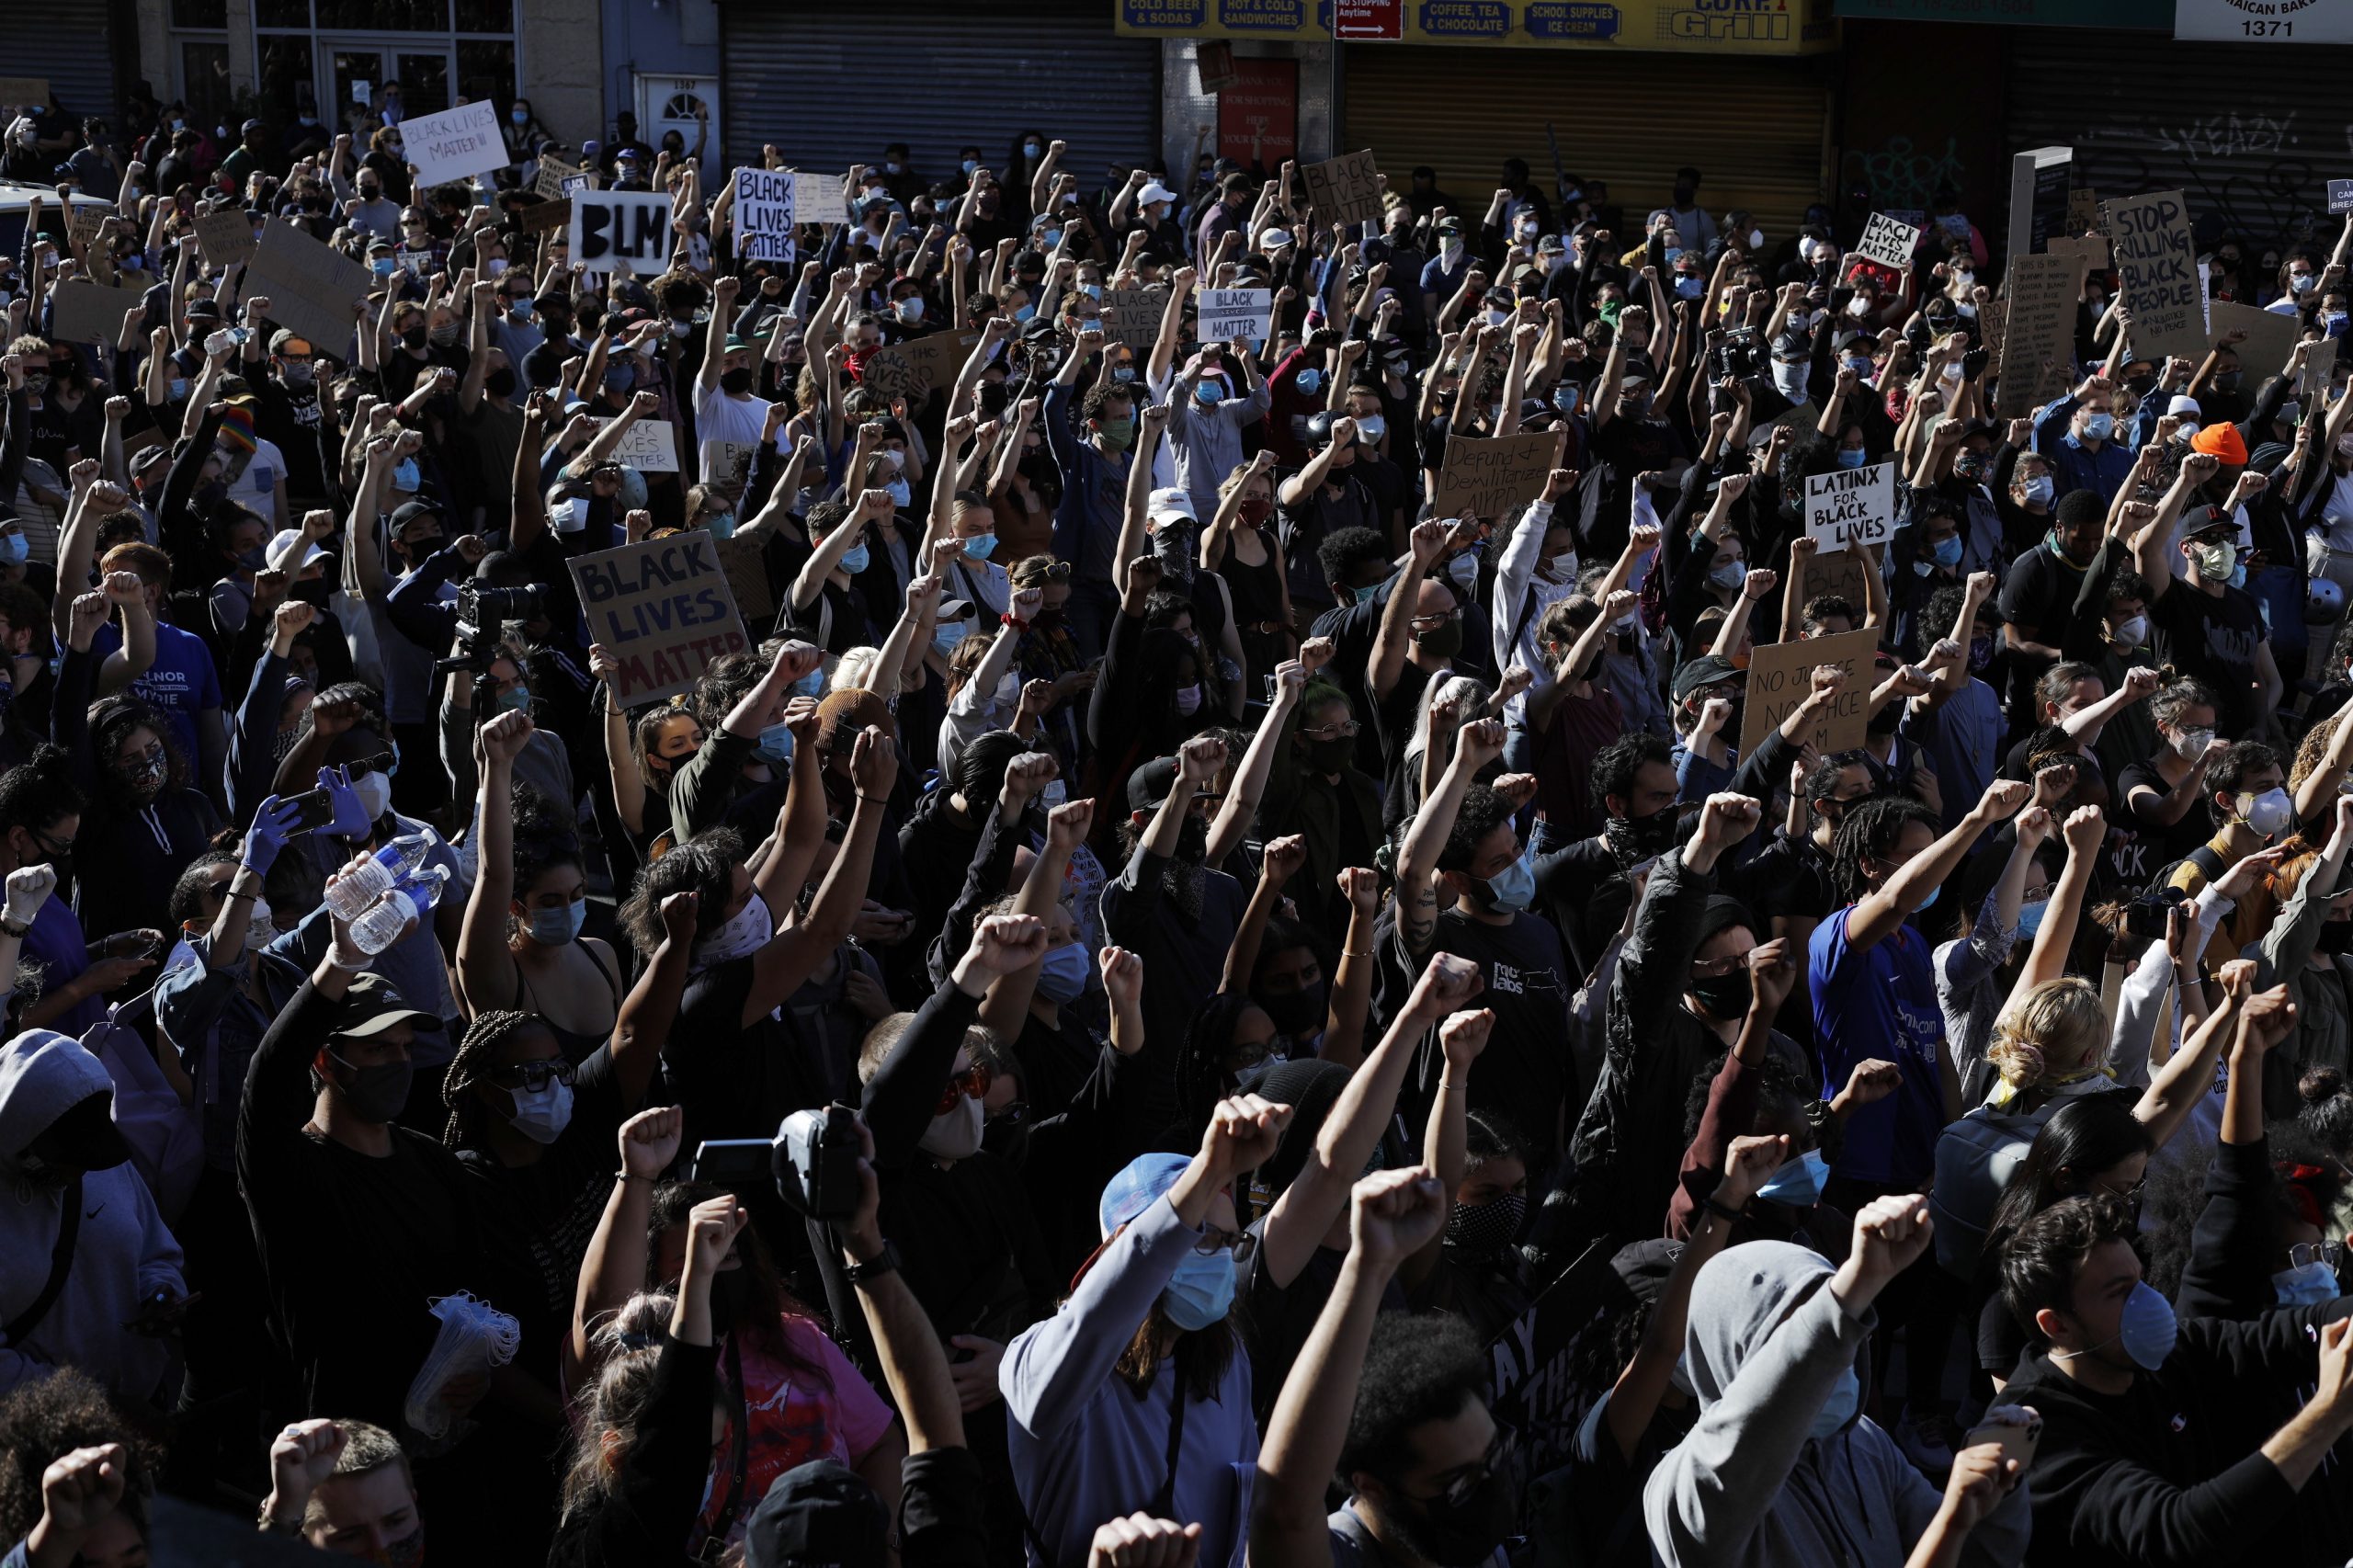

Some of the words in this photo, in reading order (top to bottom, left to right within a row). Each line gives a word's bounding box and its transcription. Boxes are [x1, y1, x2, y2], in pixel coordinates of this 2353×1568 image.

[1130, 0, 1165, 10] COLD
[1167, 0, 1199, 10] BEER
[1136, 13, 1146, 23] &
[1150, 13, 1192, 24] SODAS
[1227, 0, 1249, 10] HOT
[1265, 0, 1295, 11] COLD
[1339, 7, 1371, 18] Anytime
[1430, 5, 1474, 17] COFFEE,
[1479, 6, 1500, 17] TEA
[1532, 6, 1566, 17] SCHOOL
[1570, 6, 1614, 19] SUPPLIES
[1223, 13, 1299, 26] SANDWICHES
[1426, 18, 1434, 28] &
[1437, 18, 1504, 31] CHOCOLATE
[1548, 21, 1563, 32] ICE
[1564, 22, 1596, 33] CREAM
[1671, 10, 1790, 40] Grill
[2242, 20, 2293, 37] 1371
[1237, 75, 1264, 85] HANK
[404, 119, 452, 144] BLACK
[453, 108, 494, 132] LIVES
[1251, 136, 1293, 145] BSINESS
[1308, 157, 1373, 188] BLACK
[742, 172, 791, 204] BLACK
[1313, 176, 1376, 207] LIVES
[744, 203, 791, 233] LIVES
[1319, 195, 1385, 229] MATTER
[2117, 200, 2179, 236] STOP
[582, 203, 666, 259] BLM
[2118, 228, 2189, 261] KILLING
[1858, 241, 1906, 265] MATTER
[2123, 257, 2189, 290] BLACK
[1103, 293, 1162, 308] BLACK
[1216, 291, 1255, 307] BLACK
[2127, 283, 2194, 314] PEOPLE
[1211, 318, 1256, 337] MATTER
[871, 351, 909, 369] BLACK
[864, 366, 910, 391] LIVES
[1450, 440, 1516, 472] Defund
[1446, 466, 1548, 492] Demilitarize
[1811, 466, 1881, 496] LATINX
[1834, 491, 1859, 506] FOR
[1814, 502, 1869, 527] BLACK
[1836, 516, 1885, 544] LIVES
[578, 541, 716, 603] BLACK
[1803, 565, 1863, 597] BLAC
[607, 587, 728, 643] LIVES
[617, 631, 745, 699] MATTER
[1756, 670, 1784, 695] NO
[1792, 658, 1856, 686] JUCE
[2111, 844, 2147, 877] ACK
[1493, 1307, 1537, 1399] AY
